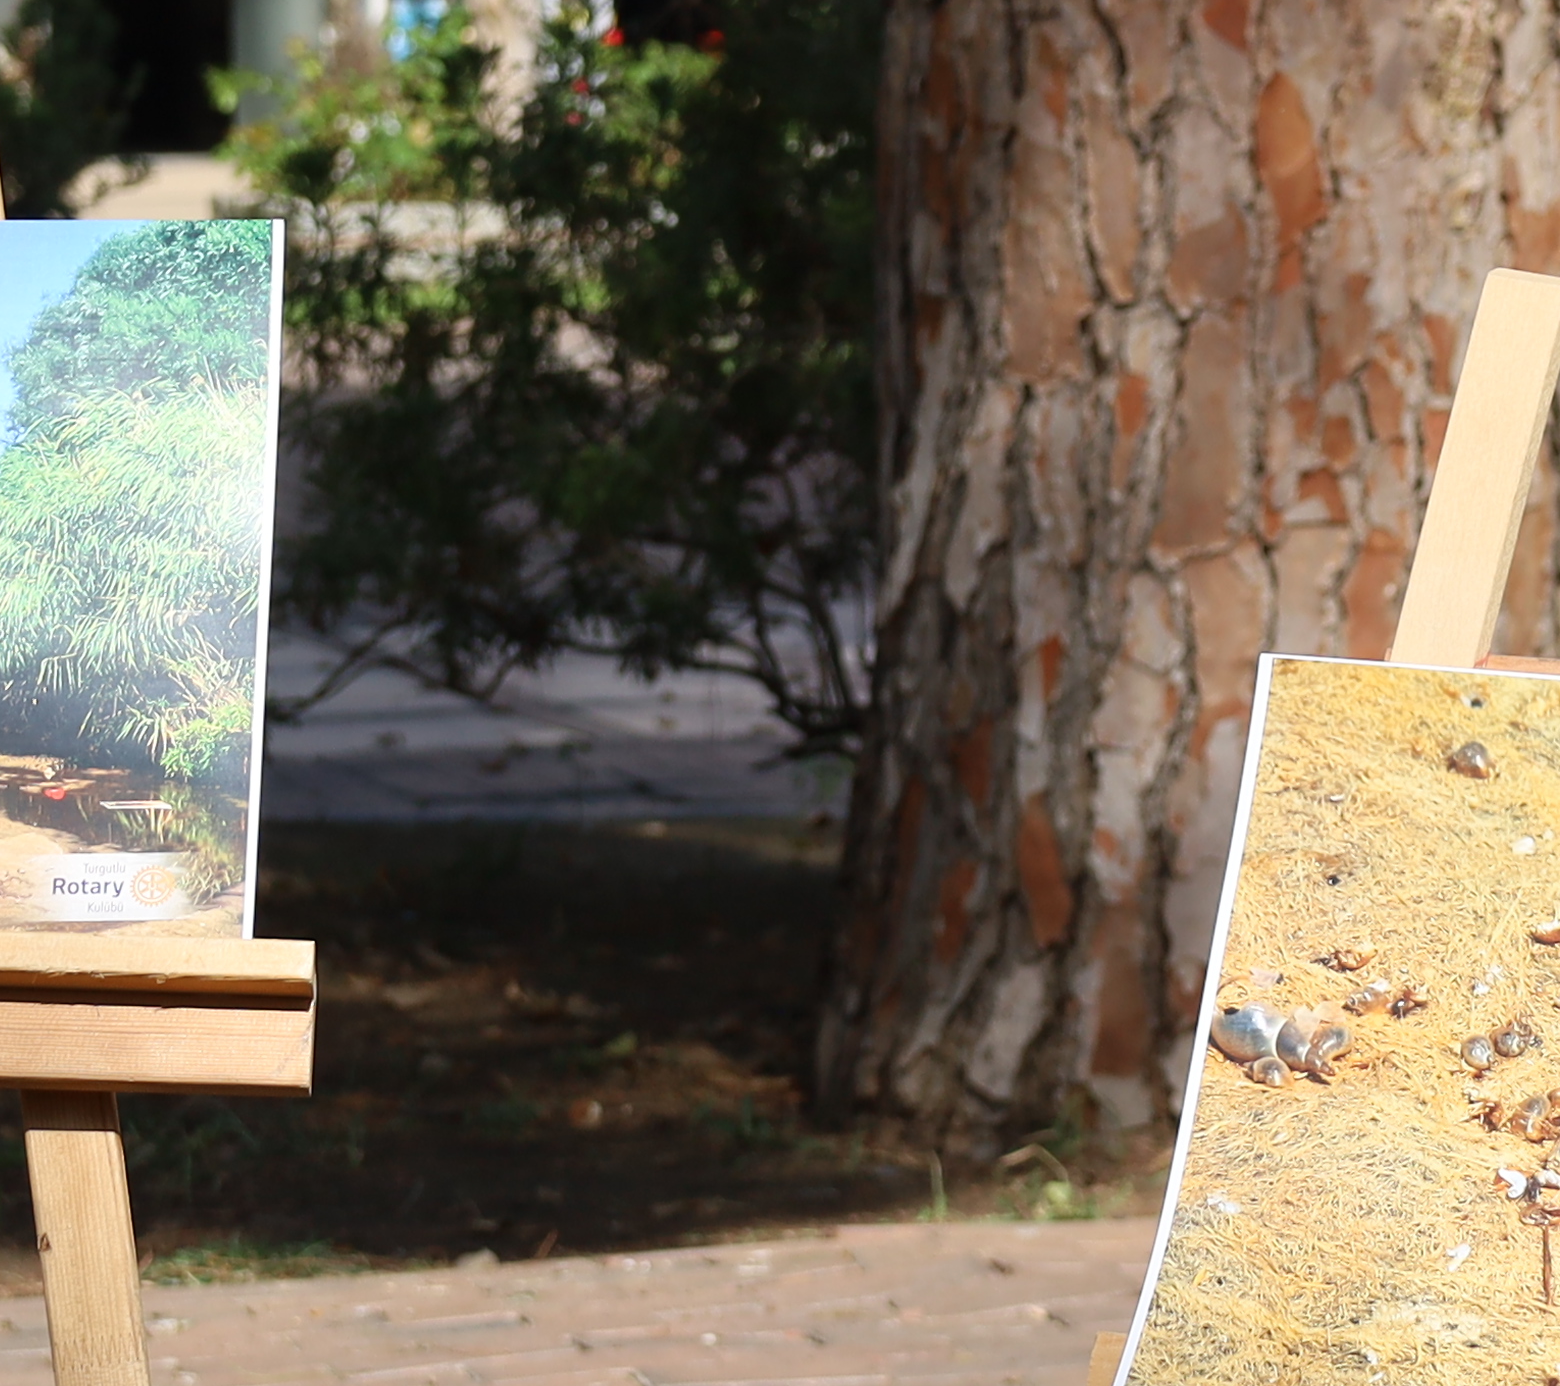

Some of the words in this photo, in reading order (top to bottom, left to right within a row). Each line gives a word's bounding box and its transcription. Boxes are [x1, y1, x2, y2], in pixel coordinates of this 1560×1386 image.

[84, 862, 126, 876] Turgutlu
[52, 877, 124, 898] Rotary
[87, 901, 124, 913] Kulübü
